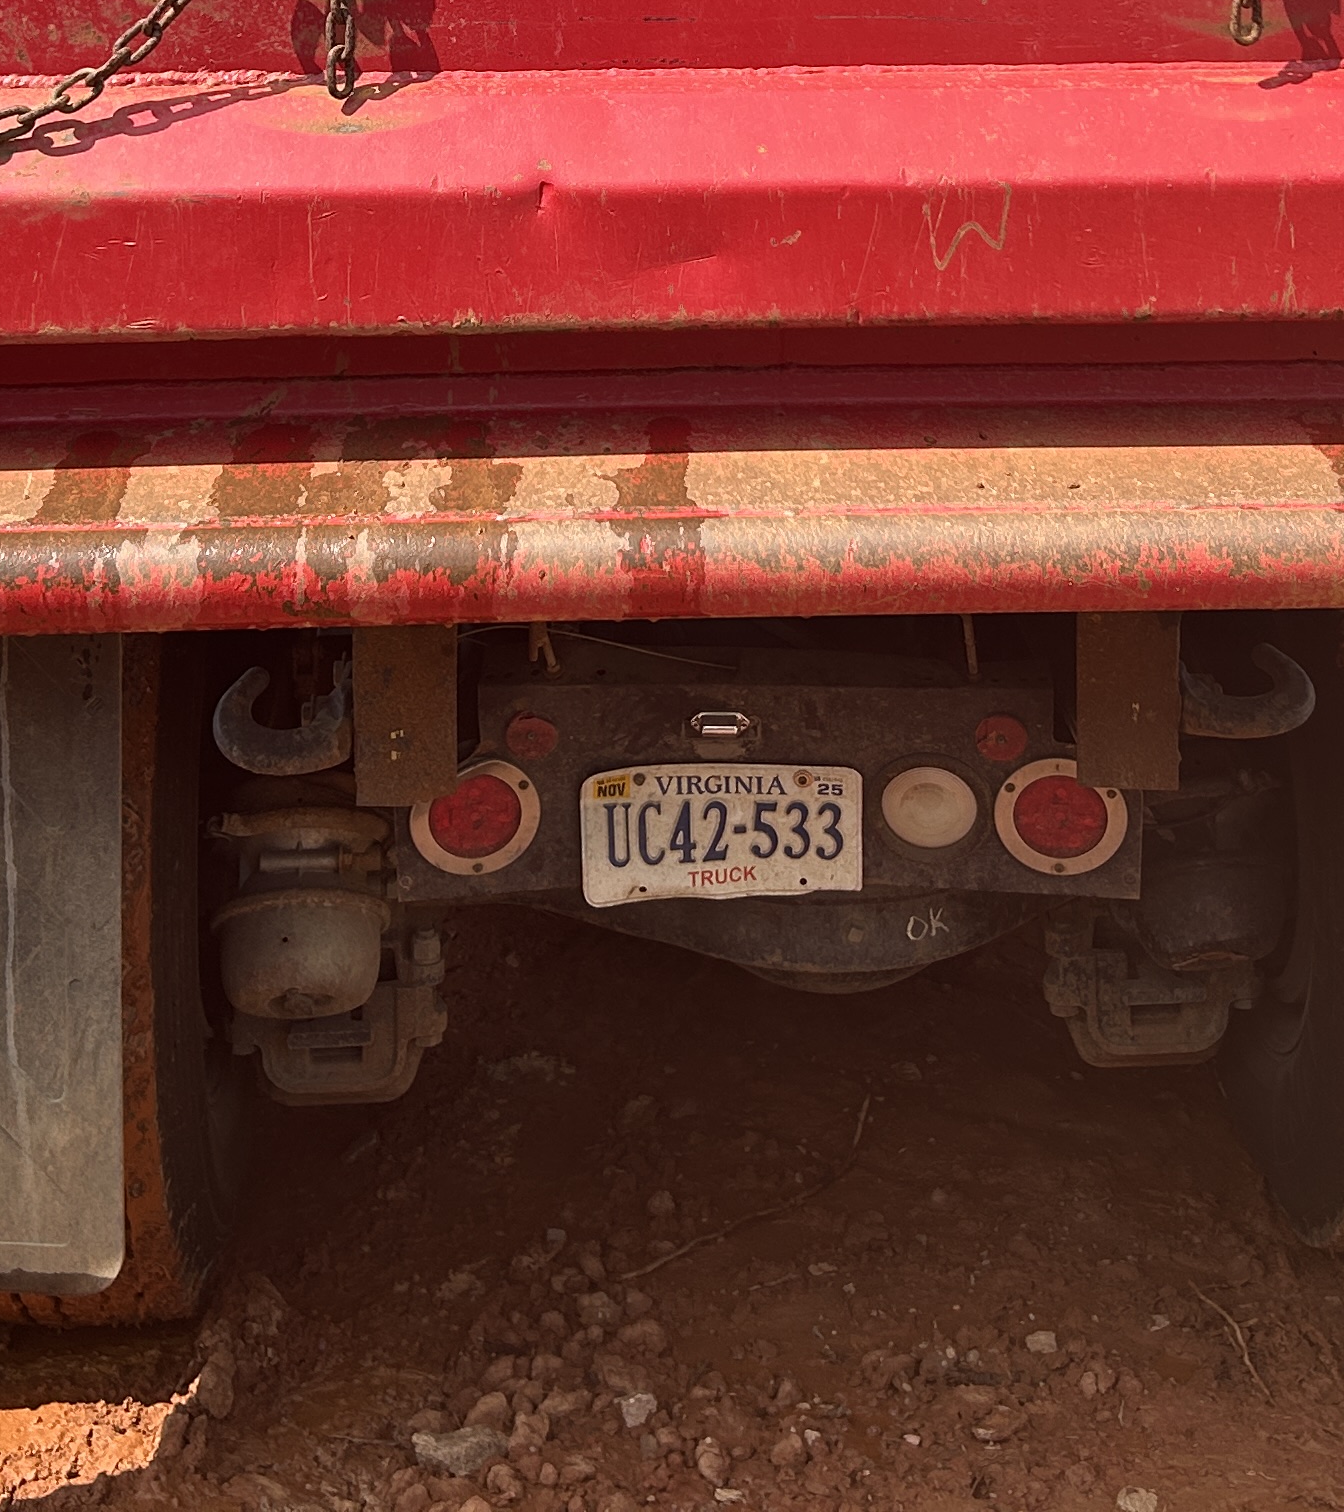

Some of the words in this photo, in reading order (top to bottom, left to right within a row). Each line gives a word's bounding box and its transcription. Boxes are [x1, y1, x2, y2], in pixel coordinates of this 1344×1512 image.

[597, 782, 626, 797] NOV
[655, 774, 787, 795] VIRGINIA
[817, 783, 844, 796] 25
[603, 800, 844, 868] UC42-533
[688, 866, 757, 887] TRUCK
[906, 907, 950, 940] OK
